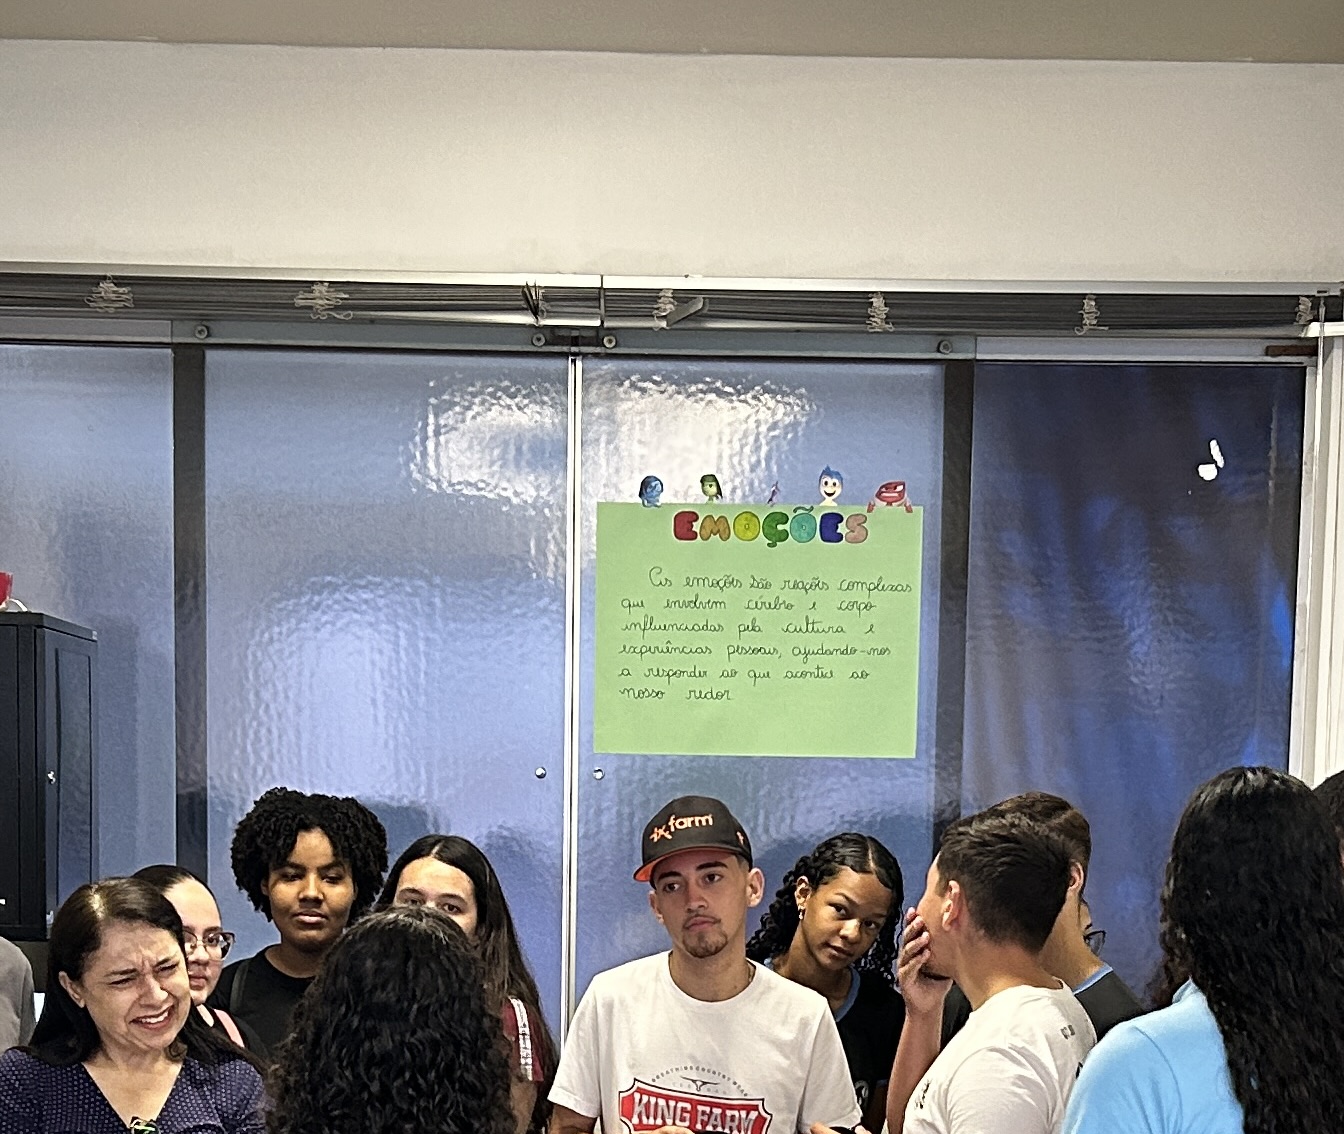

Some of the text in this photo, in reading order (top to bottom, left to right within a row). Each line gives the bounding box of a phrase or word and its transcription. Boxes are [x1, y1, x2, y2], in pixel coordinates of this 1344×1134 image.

[673, 505, 868, 548] EMOÇÕES
[649, 566, 912, 598] As emoções são reações complexas
[621, 598, 645, 615] que
[664, 593, 726, 609] envolvem
[744, 594, 795, 611] cérebro
[837, 600, 876, 618] corpo
[621, 614, 724, 640] influenciadas
[738, 617, 763, 640] pela
[782, 615, 846, 634] cultura
[618, 640, 712, 661] experiências
[618, 665, 870, 686] a responder ao que acontece ao
[619, 687, 732, 701] nosso redor
[631, 1092, 692, 1127] KING
